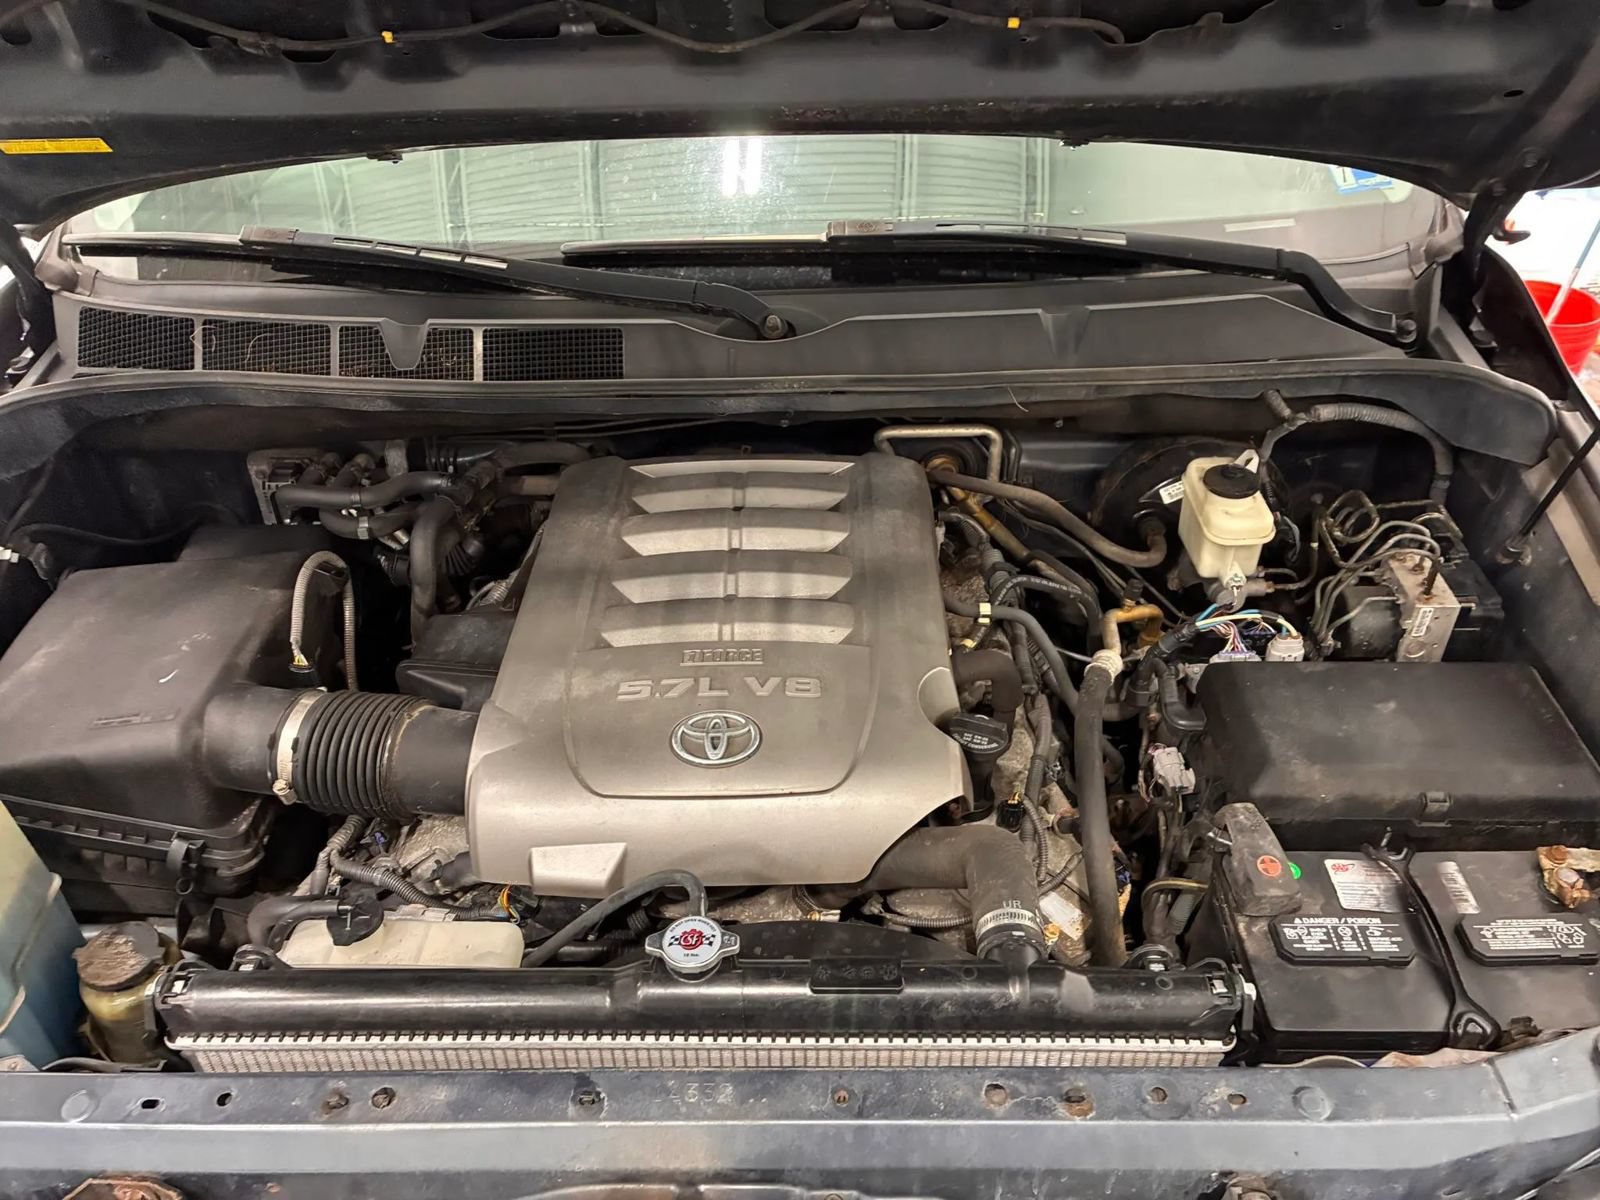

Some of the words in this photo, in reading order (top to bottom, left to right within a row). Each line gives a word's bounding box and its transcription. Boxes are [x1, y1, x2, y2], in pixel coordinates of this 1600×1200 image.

[616, 676, 729, 701] 5.7L
[743, 676, 822, 698] V8
[680, 933, 700, 946] CSF
